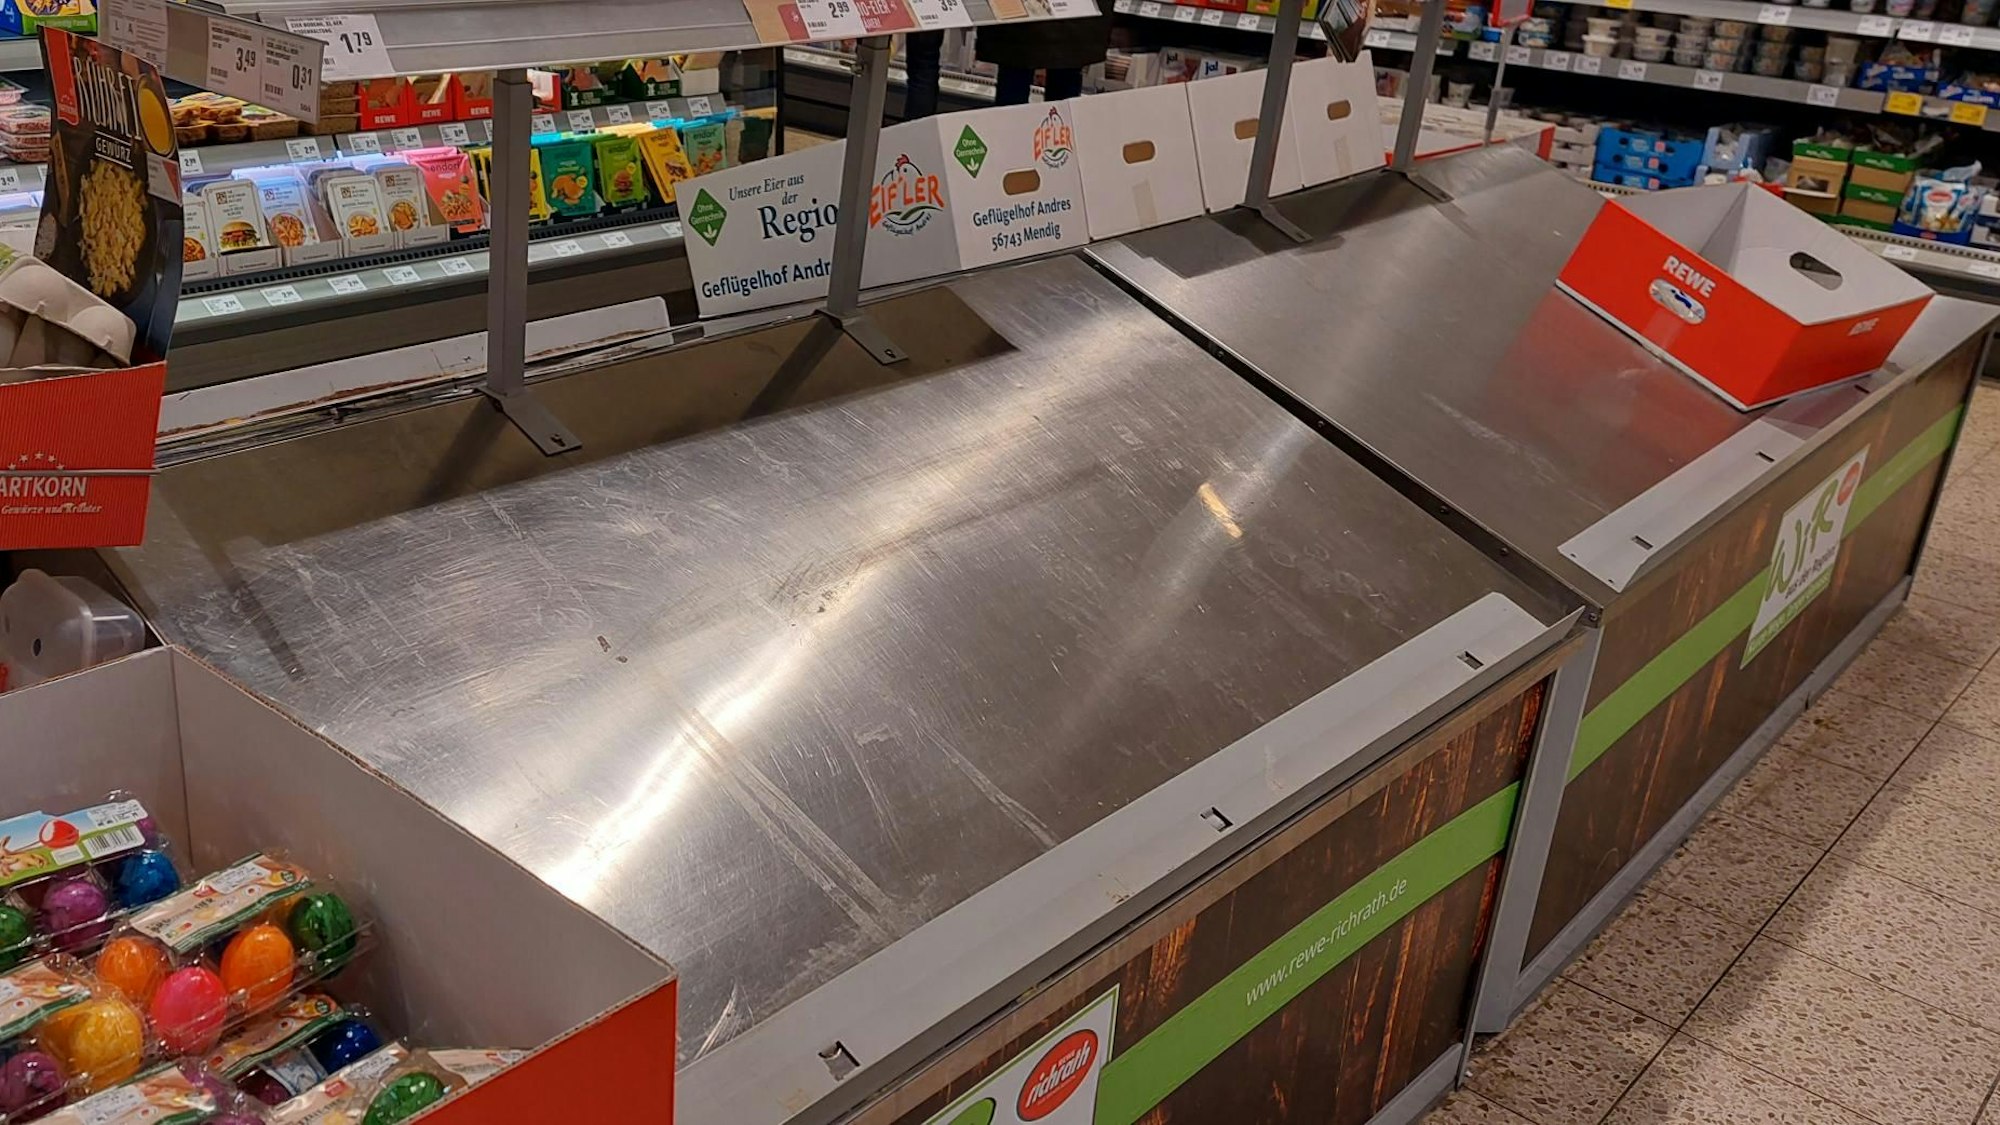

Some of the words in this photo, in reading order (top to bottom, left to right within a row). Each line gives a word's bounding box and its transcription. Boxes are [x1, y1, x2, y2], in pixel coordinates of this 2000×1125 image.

[828, 1, 850, 18] 2.99
[340, 31, 373, 54] 1.79
[236, 47, 256, 72] 3.49
[1205, 61, 1219, 75] ja!
[292, 64, 312, 91] 0.31
[374, 114, 396, 124] REWE
[422, 108, 442, 118] REWE
[470, 106, 490, 116] REWE
[95, 137, 132, 163] GEWÜRZ
[1033, 126, 1073, 162] EIFLER
[729, 187, 762, 201] Unsere
[763, 178, 786, 193] Eier
[787, 174, 805, 186] aus
[781, 192, 799, 206] der
[868, 175, 945, 229] EIFLER
[973, 201, 1035, 227] Geflügelhof
[1037, 197, 1071, 215] Andres
[757, 197, 839, 243] Regio
[991, 232, 1022, 251] 56743
[1023, 221, 1061, 240] Mendig
[702, 265, 788, 298] Geflügelhof
[793, 258, 831, 282] Andr
[1662, 255, 1716, 299] REWE
[1, 504, 44, 515] Gewürze
[45, 504, 63, 514] und
[1246, 878, 1407, 1006] www.rewe-richrath.de
[1025, 1039, 1091, 1109] richrath
